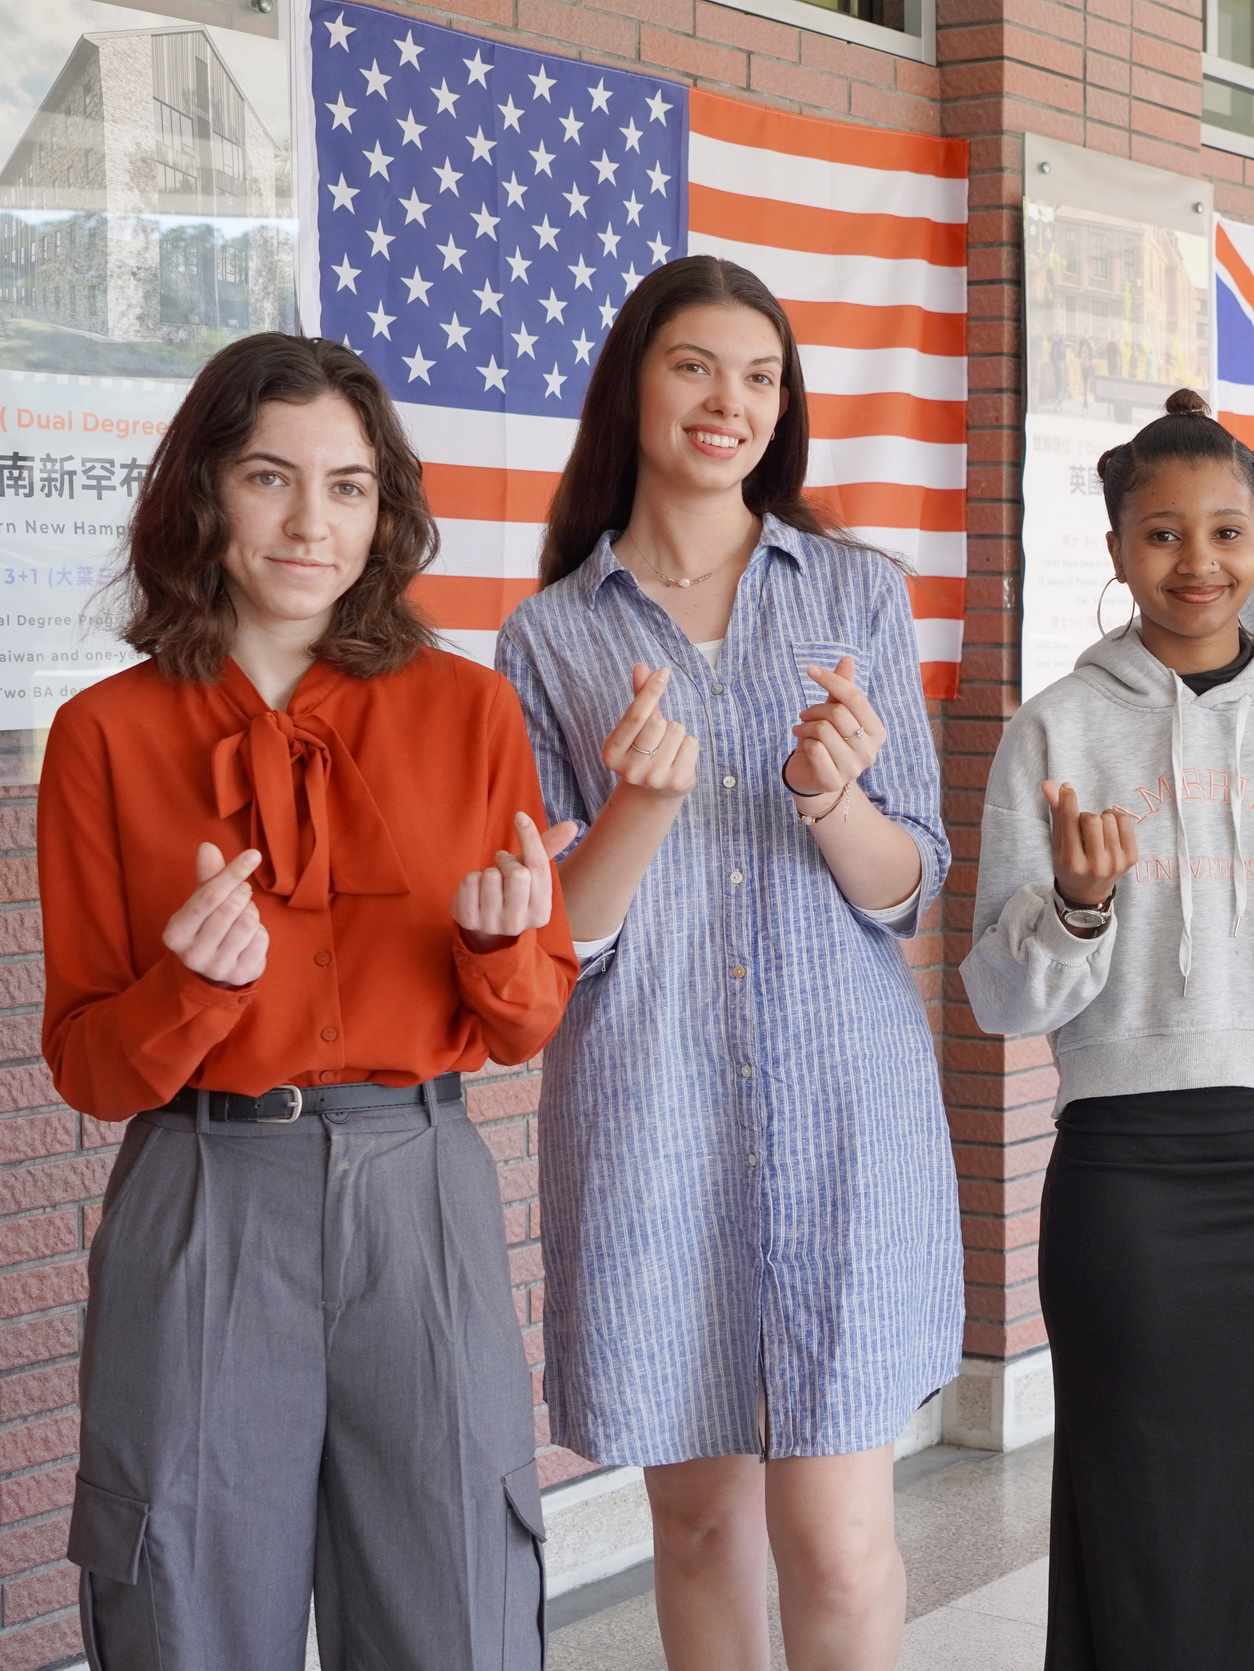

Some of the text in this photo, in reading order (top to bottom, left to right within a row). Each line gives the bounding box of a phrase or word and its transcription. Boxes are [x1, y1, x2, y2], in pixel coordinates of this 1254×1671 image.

[17, 408, 73, 431] Dual
[83, 412, 168, 439] Degree
[25, 520, 66, 534] New
[4, 568, 38, 585] 3+1
[17, 615, 71, 628] Degree
[52, 650, 79, 661] and
[33, 687, 53, 697] BA
